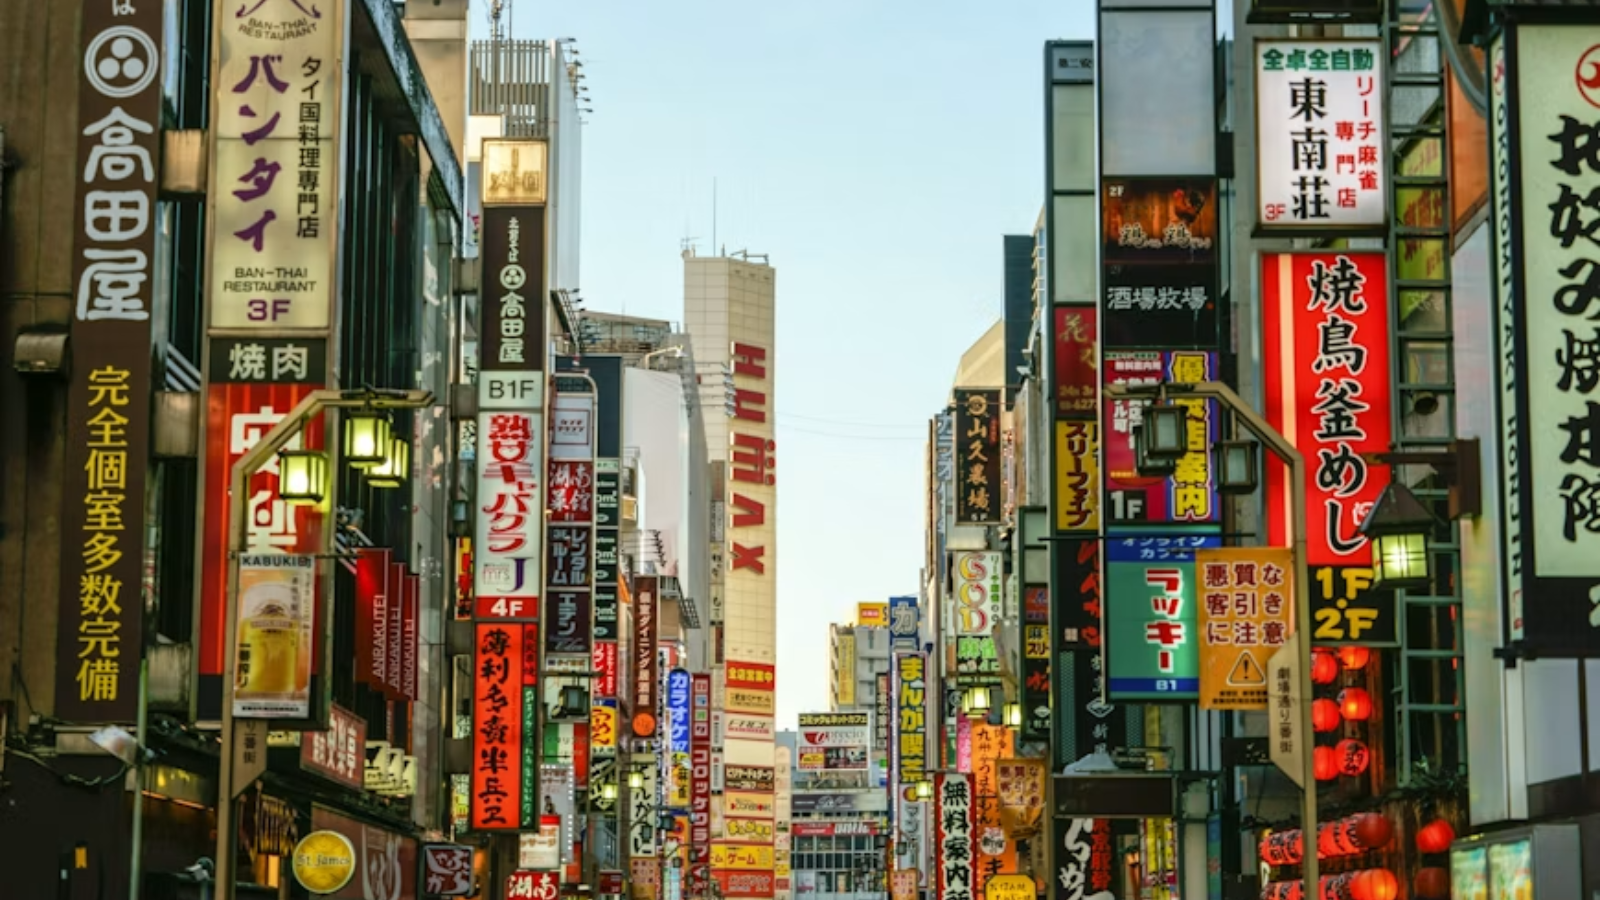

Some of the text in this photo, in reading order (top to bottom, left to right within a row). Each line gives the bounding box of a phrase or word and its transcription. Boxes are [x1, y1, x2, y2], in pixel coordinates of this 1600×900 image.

[238, 22, 318, 40] RESTAURANT
[247, 17, 309, 29] BAN-THAI
[1262, 49, 1374, 71] 全卓全自動
[297, 56, 322, 238] タイ国料理専門店
[1289, 77, 1331, 220] 東南荘
[1356, 76, 1378, 191] リーチ麻雀
[232, 54, 289, 252] バンタイ
[1335, 121, 1357, 209] 専門店
[1109, 186, 1124, 198] 2F
[76, 106, 155, 321] 高田屋
[1265, 203, 1286, 221] 3F
[223, 281, 317, 293] RESTAURANT
[235, 267, 308, 279] BAN-THAI
[247, 300, 291, 321] 3F
[499, 292, 525, 363] 高田屋
[229, 343, 308, 380] 焼肉
[489, 380, 534, 399] B1F
[1307, 257, 1368, 555] 焼鳥釜めし
[731, 341, 776, 576] HUMAX
[1066, 422, 1092, 528] スリーファイブ
[1110, 491, 1143, 519] 1F
[76, 365, 131, 701] 完全個室多数完備
[571, 529, 587, 584] レンタル
[1140, 548, 1190, 559] カフェ
[496, 556, 534, 593] J
[1203, 563, 1284, 588] 悪質な
[1315, 566, 1376, 600] 1F
[491, 598, 524, 617] 4F
[558, 593, 577, 637] エデン
[1145, 568, 1184, 673] ラッキー
[1203, 592, 1284, 617] 客引き
[372, 593, 386, 683] ANRAKUTEI
[1206, 621, 1286, 646] に注意
[1314, 608, 1379, 640] 2F
[388, 606, 401, 693] ANRAKUTEI
[403, 618, 415, 700] ANRAKUTEI
[1155, 680, 1177, 691] B1
[900, 656, 925, 783] まんが喫茶
[1277, 667, 1294, 754] 劇場通り一番街
[727, 853, 756, 865] ゲーム
